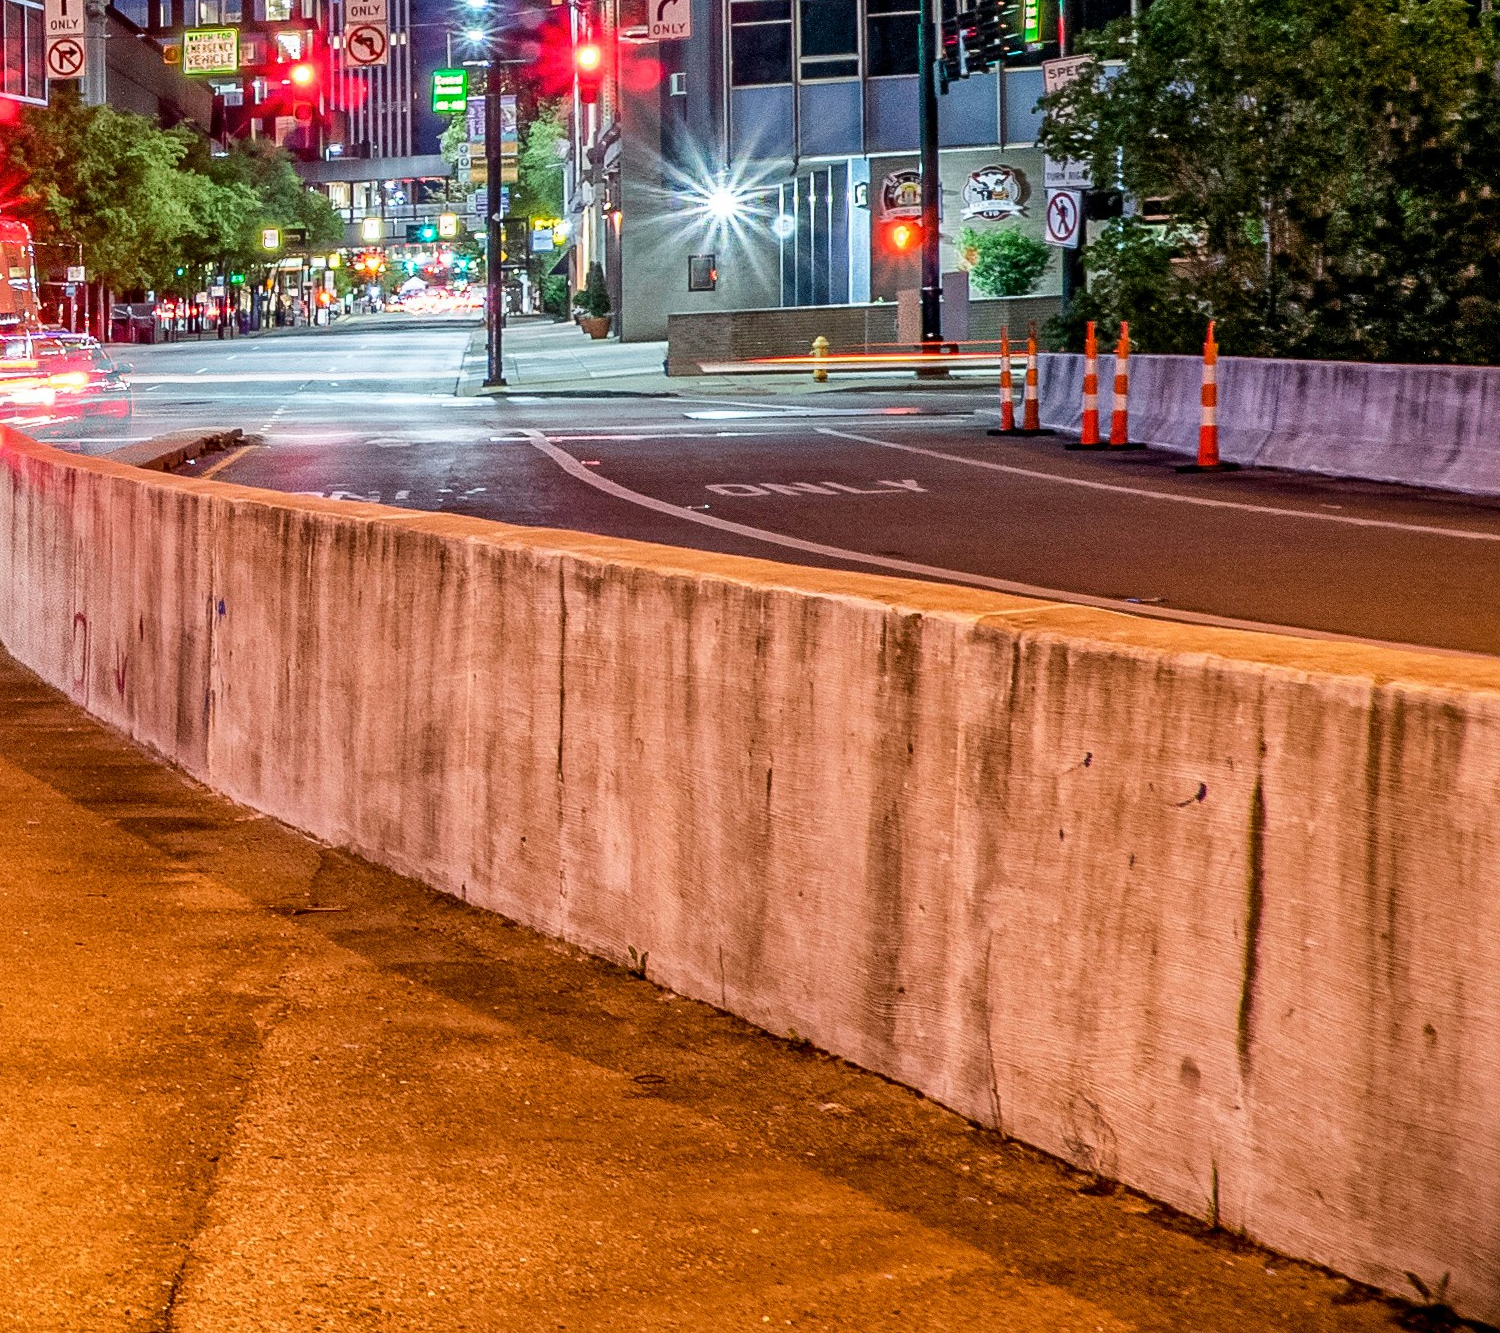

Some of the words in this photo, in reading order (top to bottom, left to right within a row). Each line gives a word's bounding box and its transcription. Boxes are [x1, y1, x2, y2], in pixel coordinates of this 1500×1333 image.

[351, 5, 381, 17] ONLY
[50, 19, 79, 31] ONLY
[652, 23, 686, 35] ONLY
[186, 52, 234, 65] VEHICLE
[704, 479, 928, 497] ONLY
